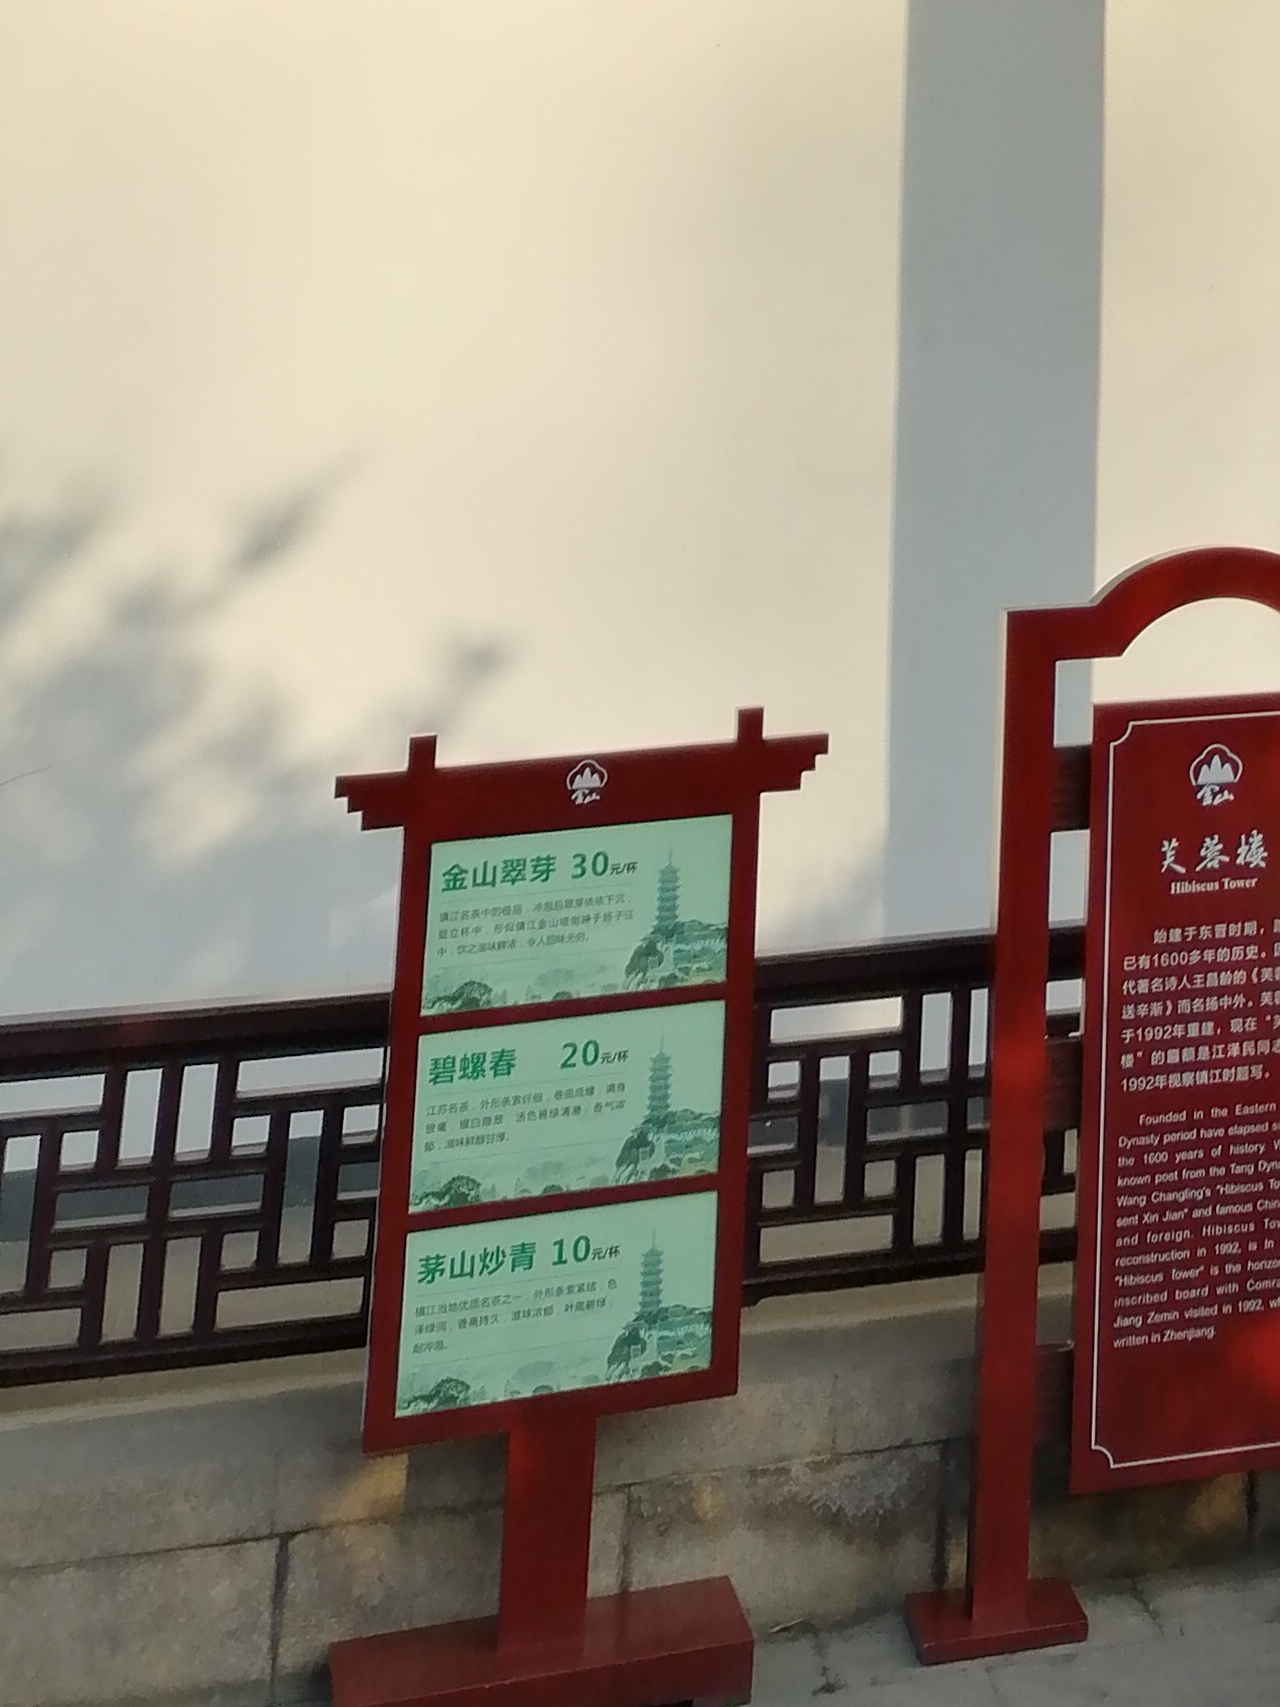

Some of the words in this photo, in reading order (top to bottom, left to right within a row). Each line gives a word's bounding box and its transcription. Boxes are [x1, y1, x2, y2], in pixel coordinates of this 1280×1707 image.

[441, 854, 557, 893] 金山翠芽
[571, 850, 638, 879] 30元/杯
[1170, 880, 1220, 895] Hibiscus
[1221, 877, 1258, 890] Tower
[428, 1047, 517, 1085] 碧螺春
[560, 1039, 629, 1070] 20元/杯
[1138, 1109, 1186, 1125] Founded
[1193, 1108, 1203, 1120] in
[1210, 1105, 1227, 1118] the
[1234, 1100, 1276, 1115] Eastern
[1118, 1132, 1160, 1149] Dynasty
[1163, 1128, 1196, 1144] period
[1200, 1125, 1224, 1138] have
[1227, 1121, 1268, 1137] elapsed
[1117, 1155, 1134, 1167] the
[1143, 1151, 1168, 1164] 1600
[1174, 1149, 1204, 1162] years
[1210, 1145, 1222, 1157] of
[1117, 1173, 1151, 1187] known
[1154, 1170, 1178, 1185] poet
[1181, 1166, 1205, 1179] from
[1208, 1164, 1225, 1176] the
[1230, 1161, 1254, 1176] Tang
[1115, 1214, 1138, 1226] sent
[1141, 1211, 1159, 1223] Xin
[1191, 1205, 1212, 1218] and
[1215, 1200, 1253, 1215] famous
[1116, 1193, 1146, 1209] Wang
[1115, 1233, 1138, 1247] and
[1201, 1220, 1254, 1236] Hibiscus
[417, 1241, 537, 1285] 茅山炒青
[552, 1235, 621, 1267] 10元/杯
[1114, 1249, 1190, 1266] reconstruction
[1196, 1246, 1206, 1257] in
[1247, 1240, 1257, 1251] is
[1264, 1238, 1273, 1249] in
[1209, 1264, 1219, 1275] is
[1224, 1261, 1241, 1273] the
[1174, 1285, 1208, 1299] board
[1215, 1282, 1239, 1294] with
[1113, 1313, 1142, 1329] Jiang
[1146, 1308, 1179, 1323] Zemin
[1183, 1304, 1218, 1318] visited
[1222, 1302, 1232, 1314] in
[1113, 1332, 1148, 1347] written
[1150, 1330, 1160, 1343] in
